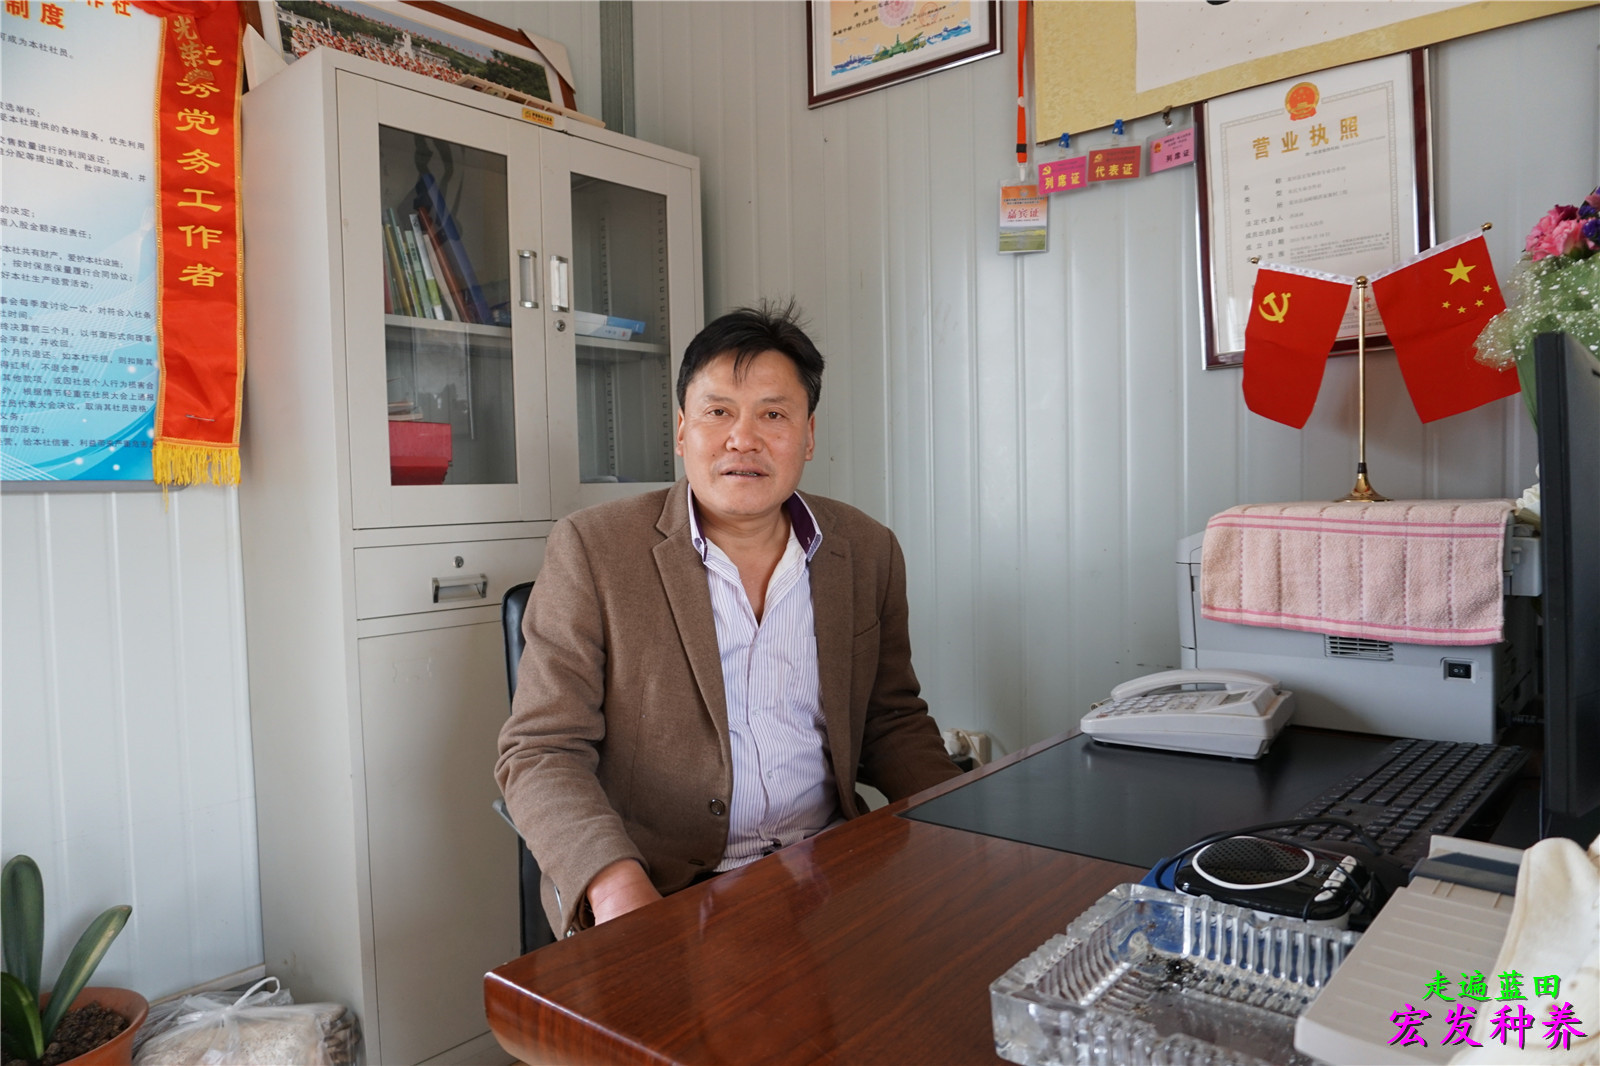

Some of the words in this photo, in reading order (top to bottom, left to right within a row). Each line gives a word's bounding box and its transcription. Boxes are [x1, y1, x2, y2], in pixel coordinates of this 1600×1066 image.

[5, 0, 65, 29] 制度
[87, 0, 131, 17] 社
[173, 15, 205, 68] 光荣
[1252, 116, 1360, 160] 营业执照
[175, 45, 224, 287] 秀党务工作者
[1095, 163, 1133, 178] 代表证
[1045, 172, 1081, 190] 列席证
